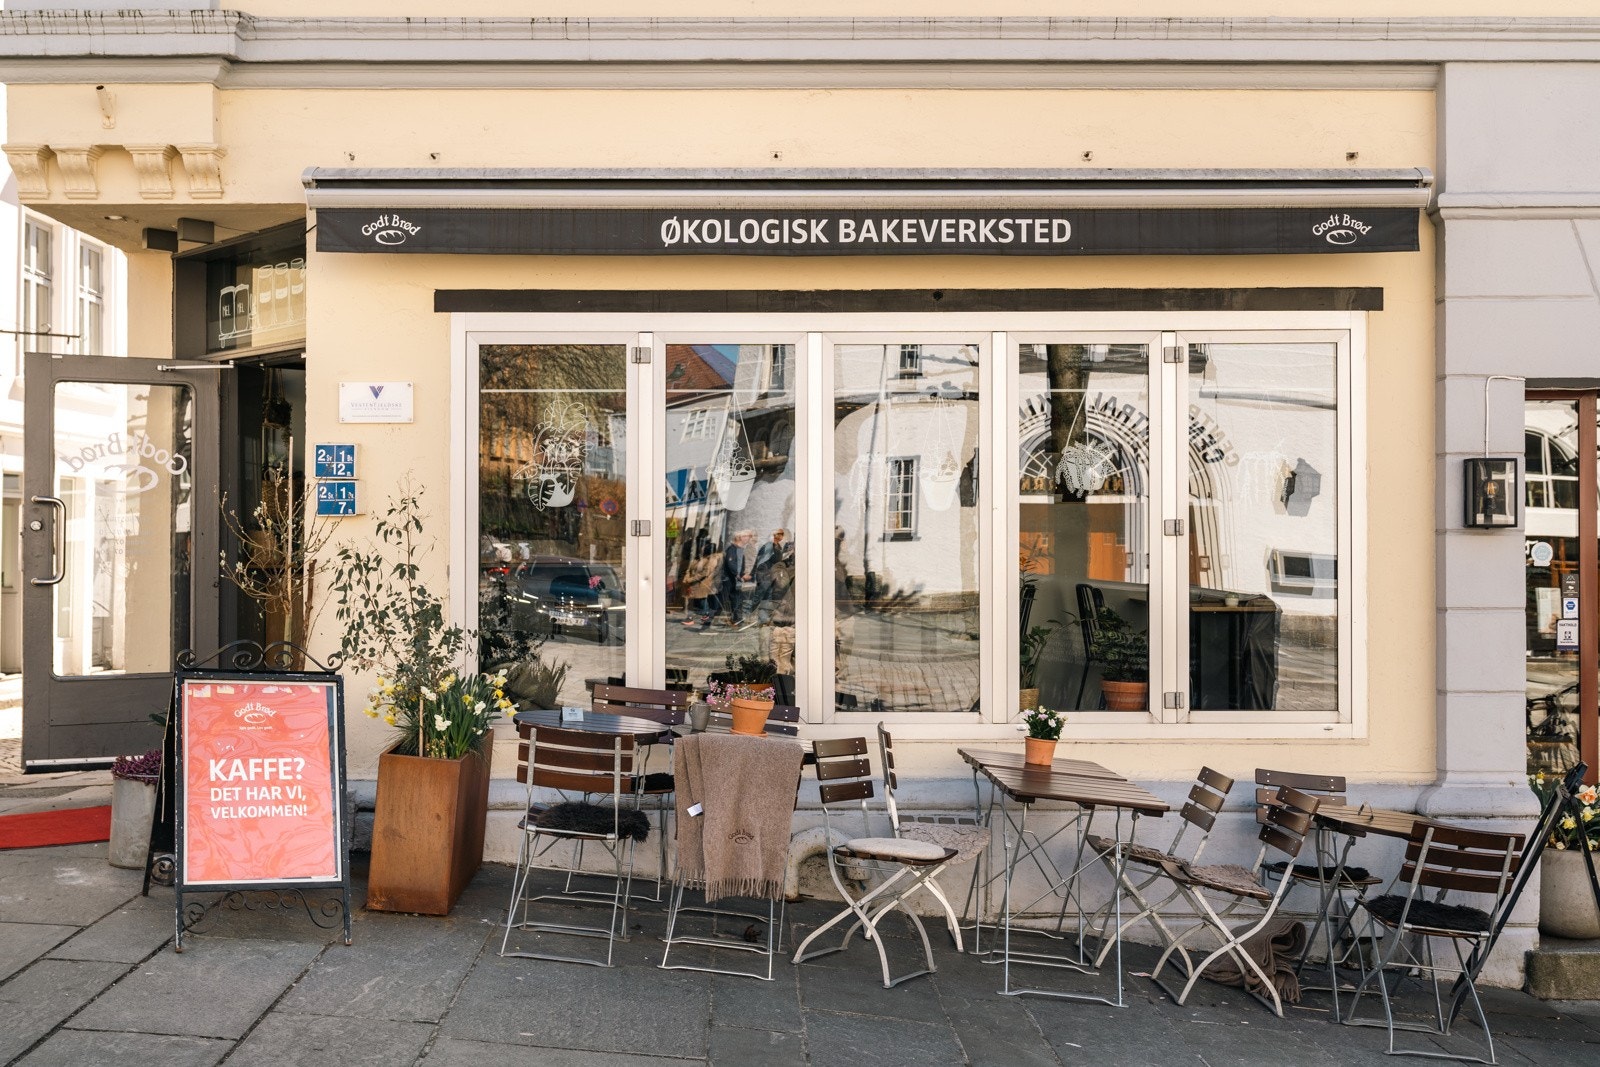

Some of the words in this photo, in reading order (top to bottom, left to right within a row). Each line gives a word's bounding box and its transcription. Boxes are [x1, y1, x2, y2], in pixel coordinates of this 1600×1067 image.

[361, 214, 389, 236] Godt
[391, 214, 422, 236] Brød
[660, 216, 829, 247] ØKOLOGISK
[838, 217, 1072, 244] BAKEVERKSTED
[1312, 214, 1340, 236] Godt
[1342, 213, 1373, 235] Brød
[317, 449, 326, 462] 2
[339, 450, 345, 462] 1
[332, 463, 346, 476] 12
[319, 486, 327, 499] 2
[340, 487, 346, 499] 1
[338, 502, 347, 514] 7
[234, 702, 254, 718] Godt
[255, 702, 277, 718] Brød
[209, 757, 306, 782] KAFFE?
[210, 786, 242, 802] DET
[246, 786, 283, 801] HAR
[286, 785, 307, 802] VI,
[210, 804, 308, 819] VELKOMMEN!
